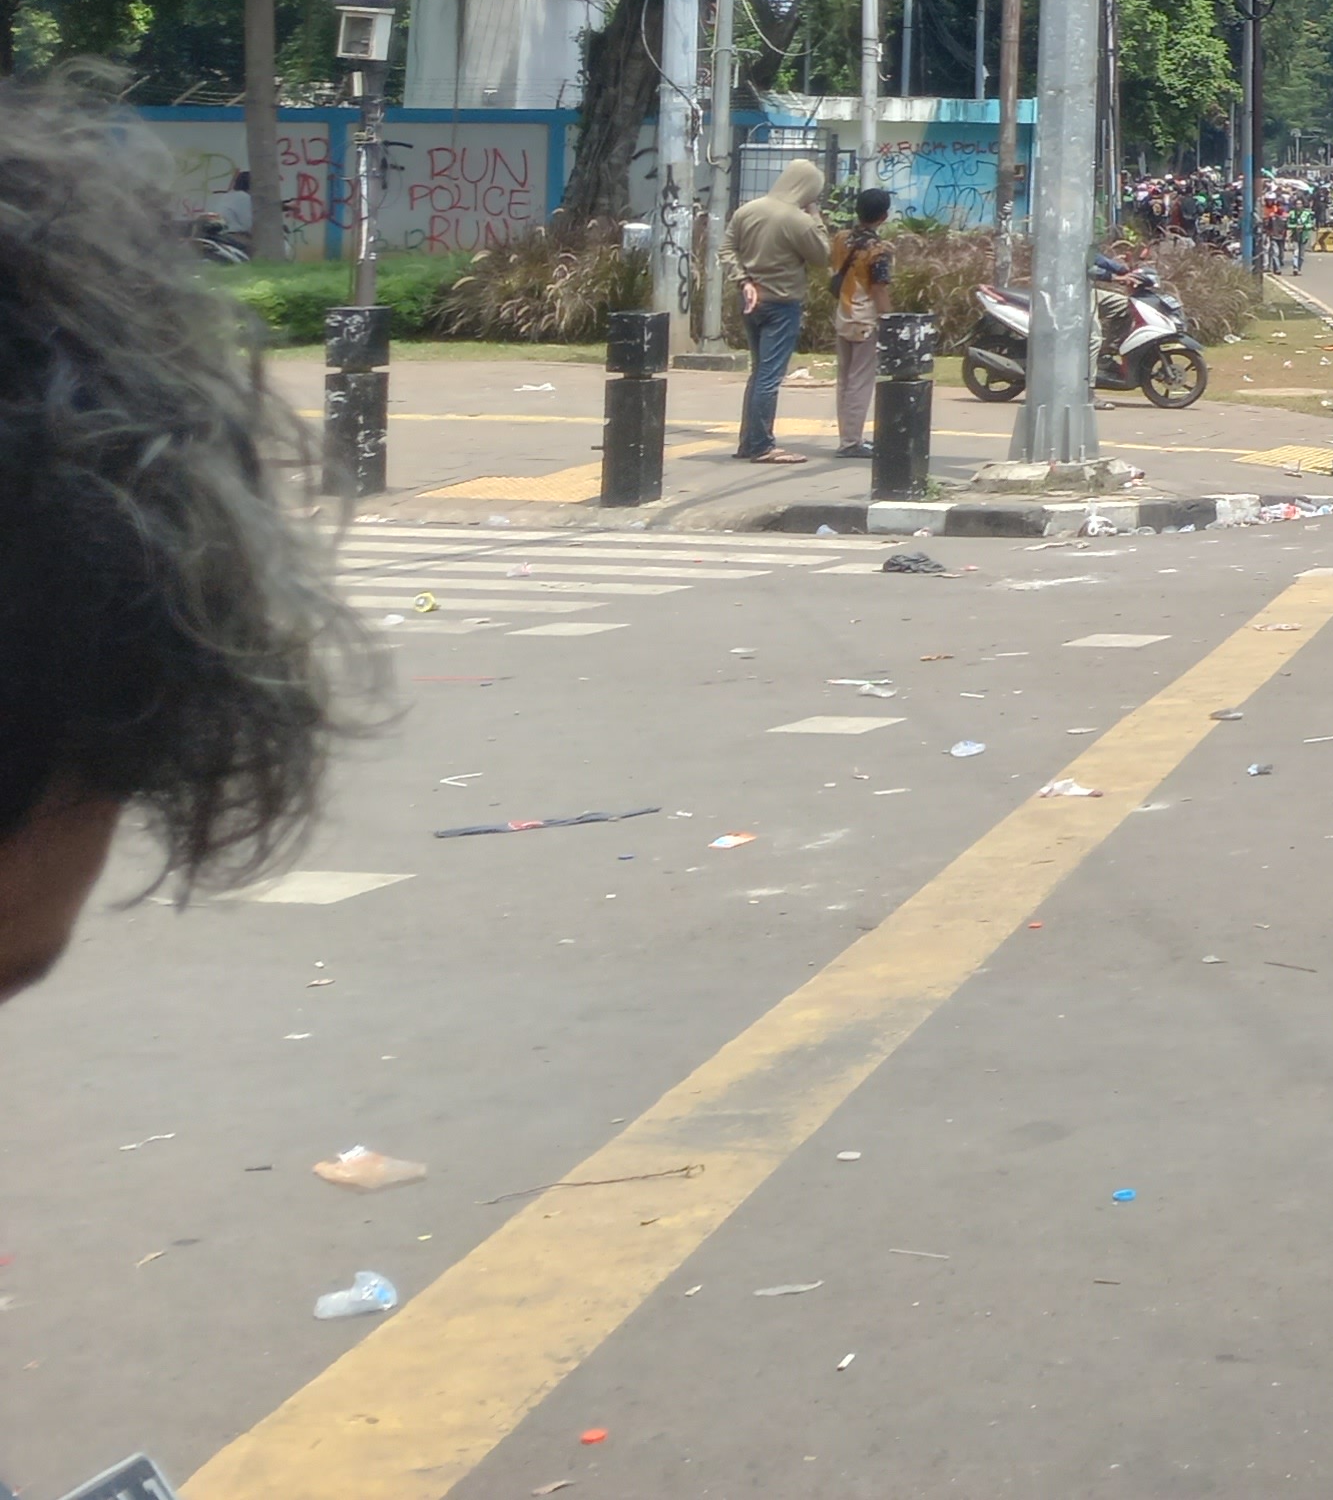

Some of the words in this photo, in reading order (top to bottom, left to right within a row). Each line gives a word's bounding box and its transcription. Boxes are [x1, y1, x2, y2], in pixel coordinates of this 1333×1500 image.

[952, 141, 999, 155] POLIC
[427, 147, 528, 188] RUN
[408, 183, 531, 220] POLICE
[425, 214, 511, 253] RUN
